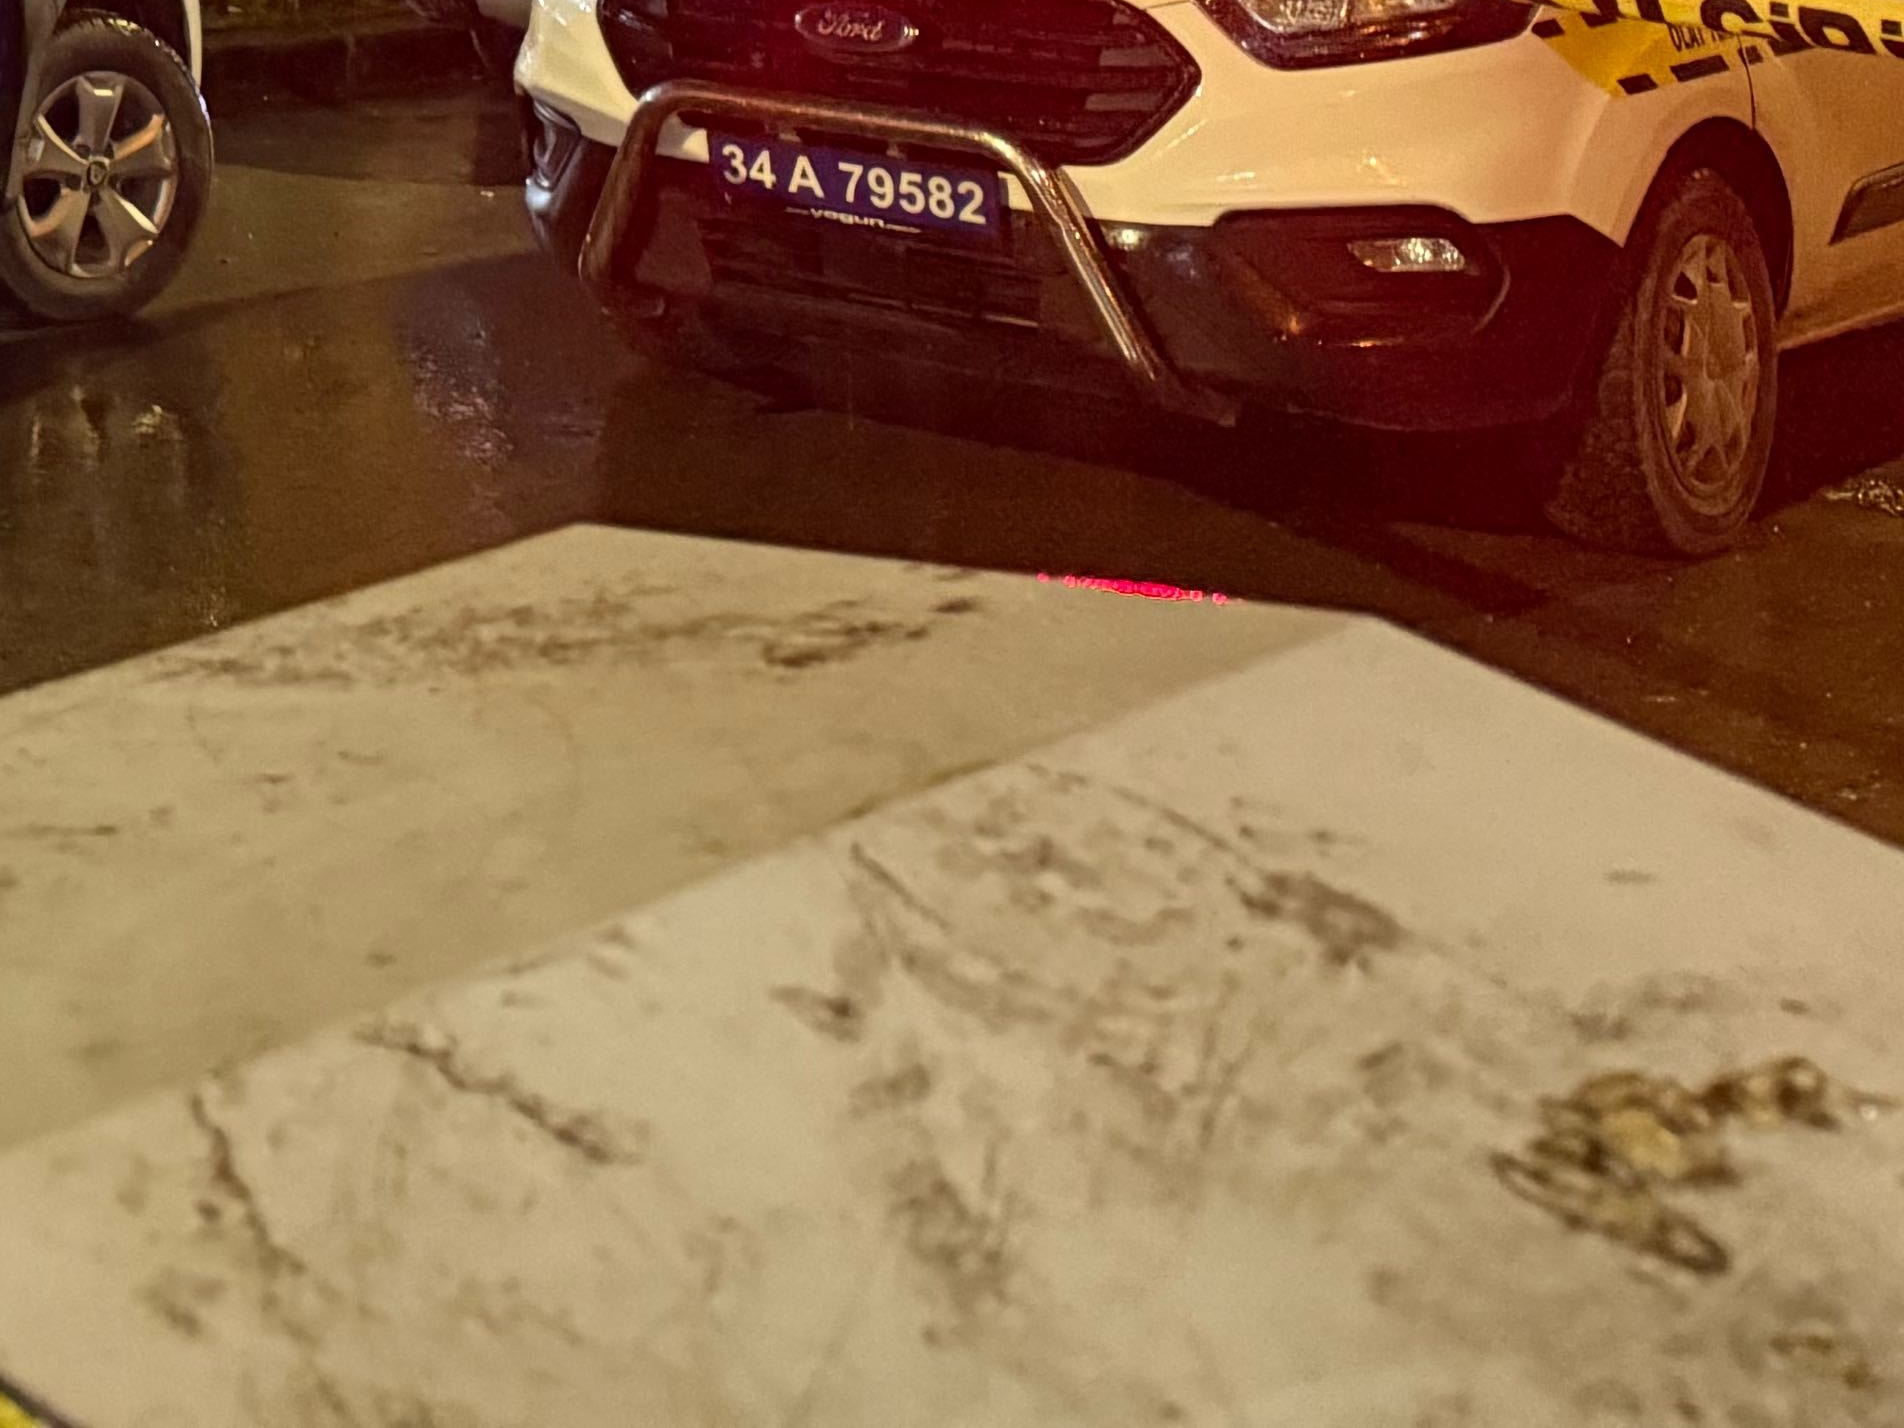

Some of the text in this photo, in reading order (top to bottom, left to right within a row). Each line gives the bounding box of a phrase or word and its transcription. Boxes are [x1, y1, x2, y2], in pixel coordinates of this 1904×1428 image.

[817, 8, 884, 42] Ford
[721, 144, 987, 225] 34 A 79582
